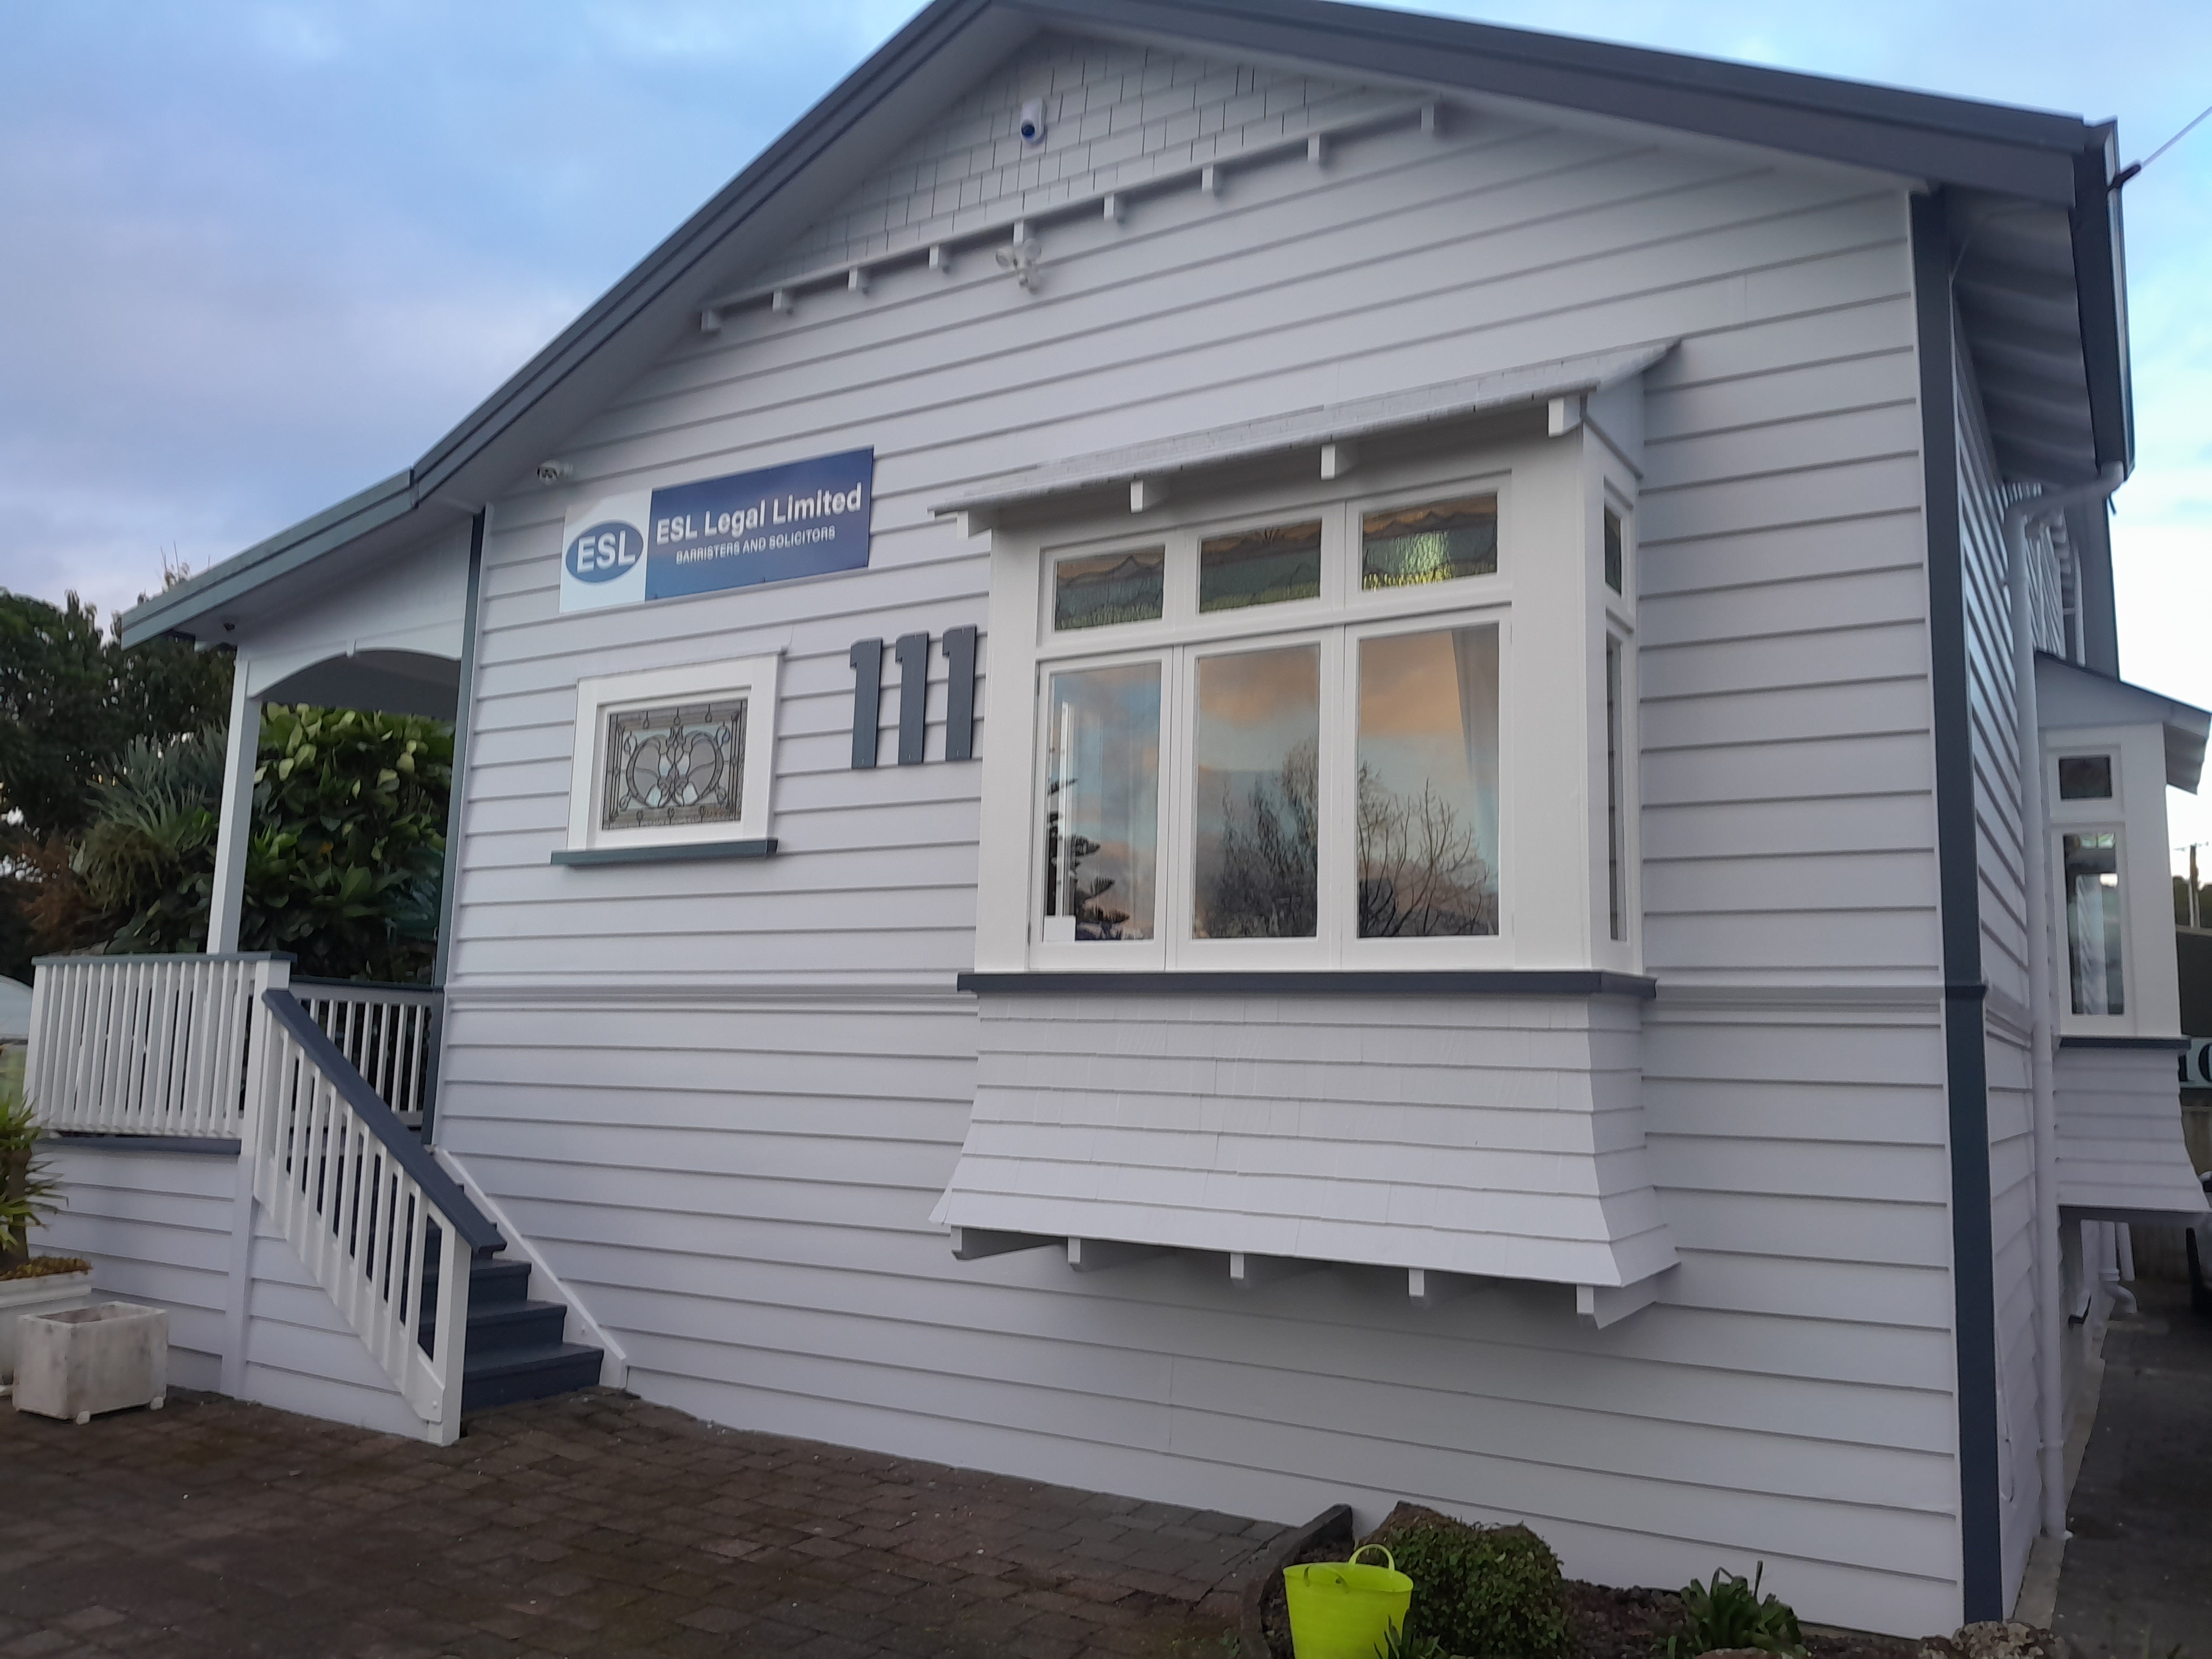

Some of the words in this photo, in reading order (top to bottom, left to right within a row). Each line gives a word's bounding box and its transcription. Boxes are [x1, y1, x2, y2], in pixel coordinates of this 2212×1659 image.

[657, 513, 698, 545] ESL
[704, 499, 766, 539] Legal
[773, 481, 862, 526] Limited
[576, 529, 636, 574] ESL
[676, 541, 740, 566] BARRISTERS
[742, 536, 767, 555] AND
[769, 524, 836, 551] SOLICITORS
[850, 623, 978, 770] 111
